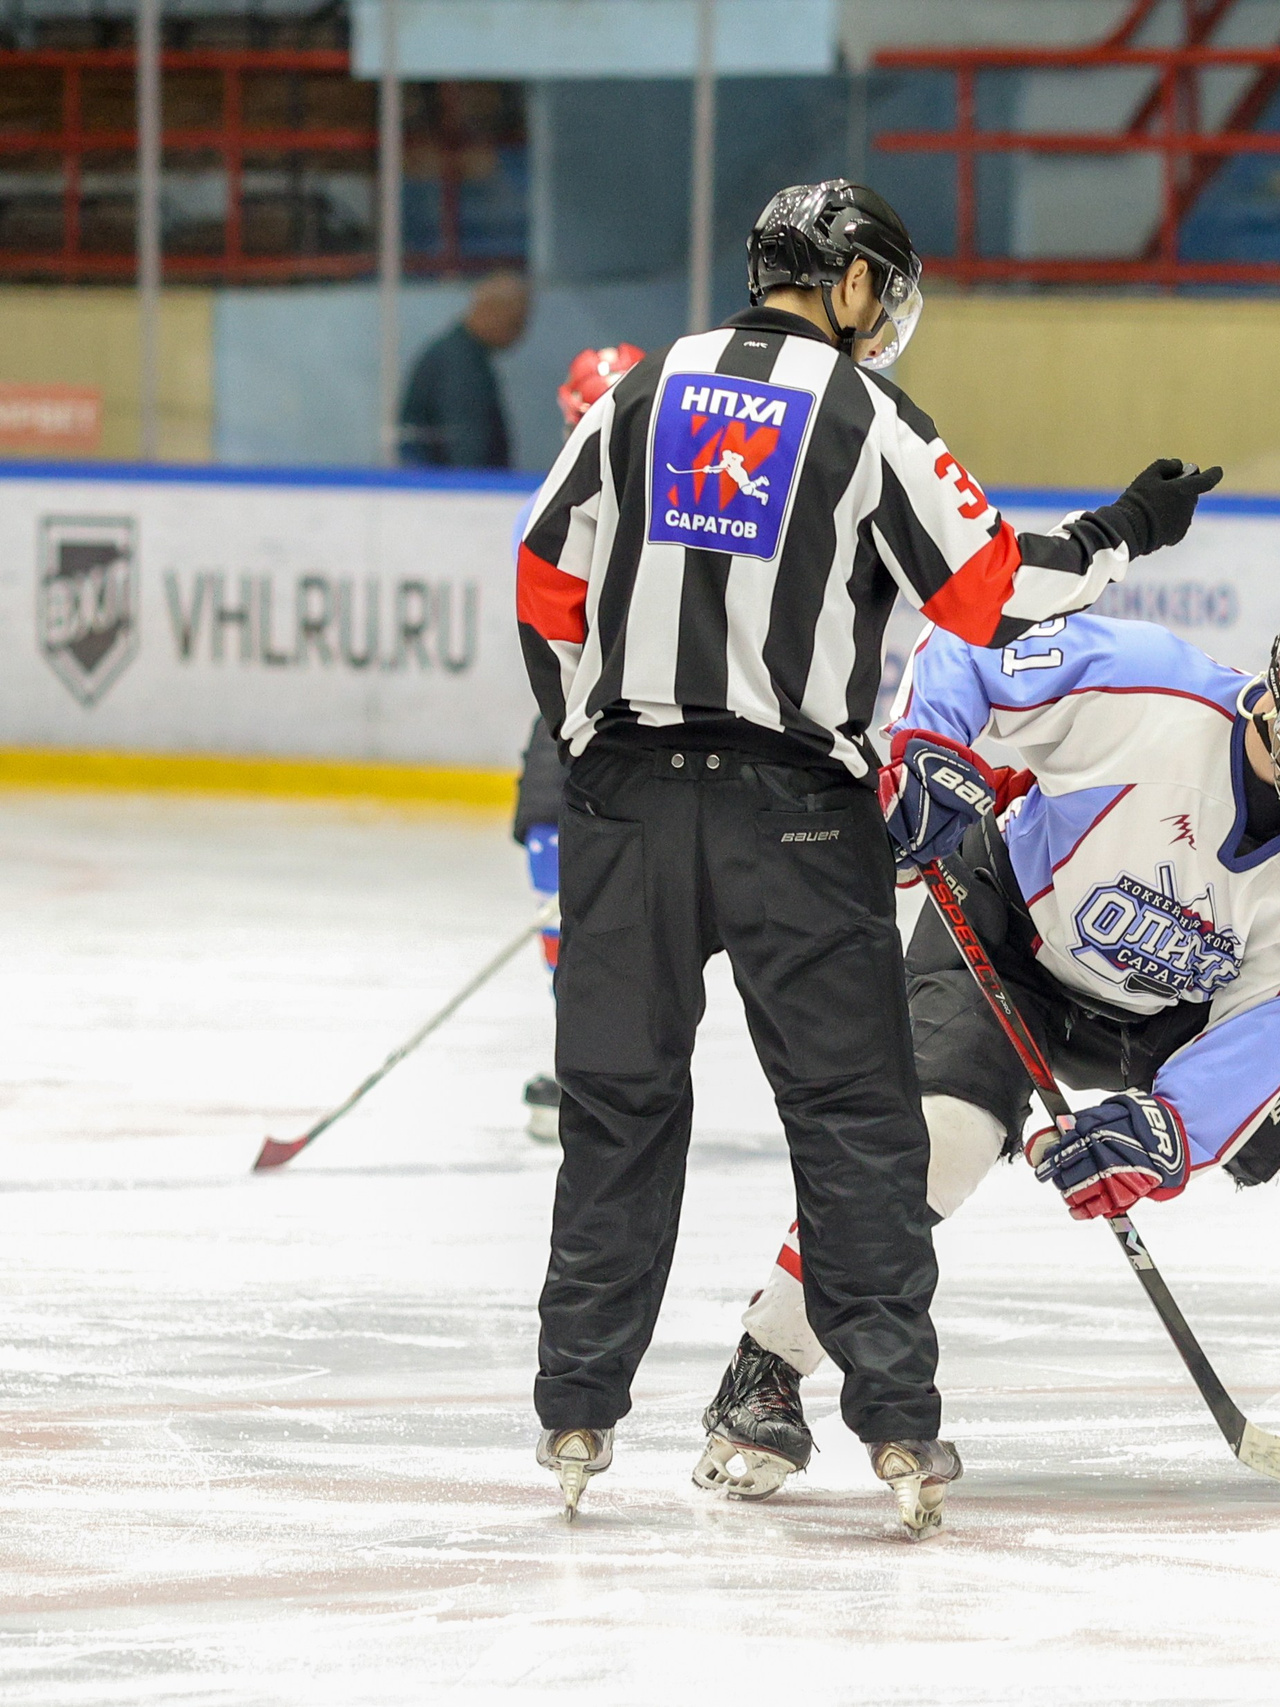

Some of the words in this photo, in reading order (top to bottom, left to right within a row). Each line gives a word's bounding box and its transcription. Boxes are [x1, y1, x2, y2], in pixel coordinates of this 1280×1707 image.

[681, 385, 787, 427] НПХЛ
[934, 452, 988, 519] 3
[664, 509, 758, 539] САРАТОВ
[930, 766, 996, 816] BAU
[780, 829, 840, 843] BAUER
[1116, 949, 1195, 990] САРАТ
[1127, 1088, 1175, 1158] UER
